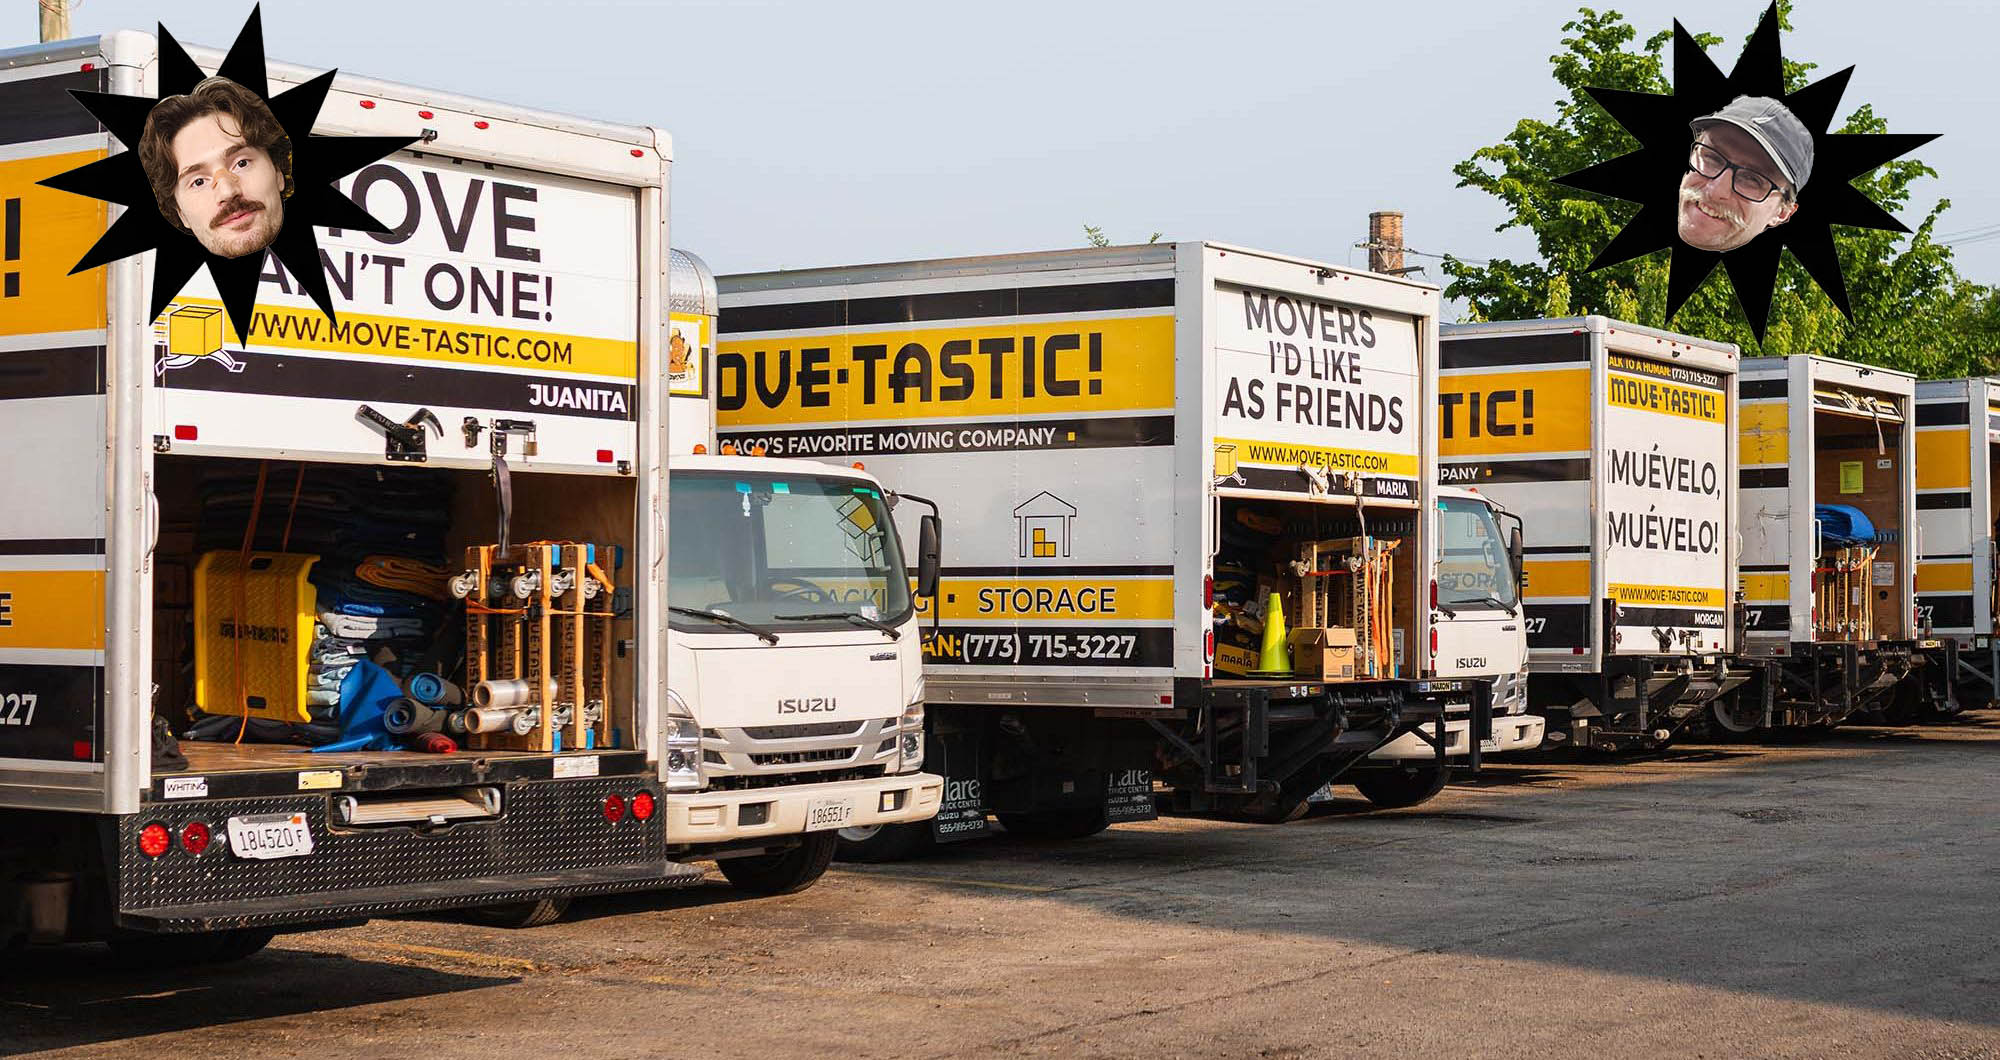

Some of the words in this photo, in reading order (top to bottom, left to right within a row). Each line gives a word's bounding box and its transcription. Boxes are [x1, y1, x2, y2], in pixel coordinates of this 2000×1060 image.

[329, 163, 541, 264] OVE
[258, 247, 405, 305] AN'T
[424, 263, 553, 323] ONE!
[1243, 291, 1376, 349] MOVERS
[1269, 340, 1301, 377] I'D
[1309, 346, 1362, 385] LIKE
[528, 383, 627, 413] JUANITA
[1222, 376, 1265, 420] AS
[1276, 383, 1403, 435] FRIENDS
[788, 432, 874, 455] FAVORITE
[879, 429, 953, 450] MOVING
[959, 427, 1056, 449] COMPANY
[1438, 467, 1478, 480] PANY
[1376, 482, 1409, 497] MARIA
[978, 587, 1116, 613] STORAGE
[1694, 613, 1723, 626] MORGAN
[1029, 635, 1136, 659] 715-3227
[1221, 655, 1252, 668] MARIA
[1456, 657, 1487, 669] ISUZU
[777, 697, 837, 714] ISUZU
[167, 782, 207, 793] WHITING
[812, 807, 843, 825] 186551
[239, 827, 294, 851] 184520
[296, 829, 303, 843] F
